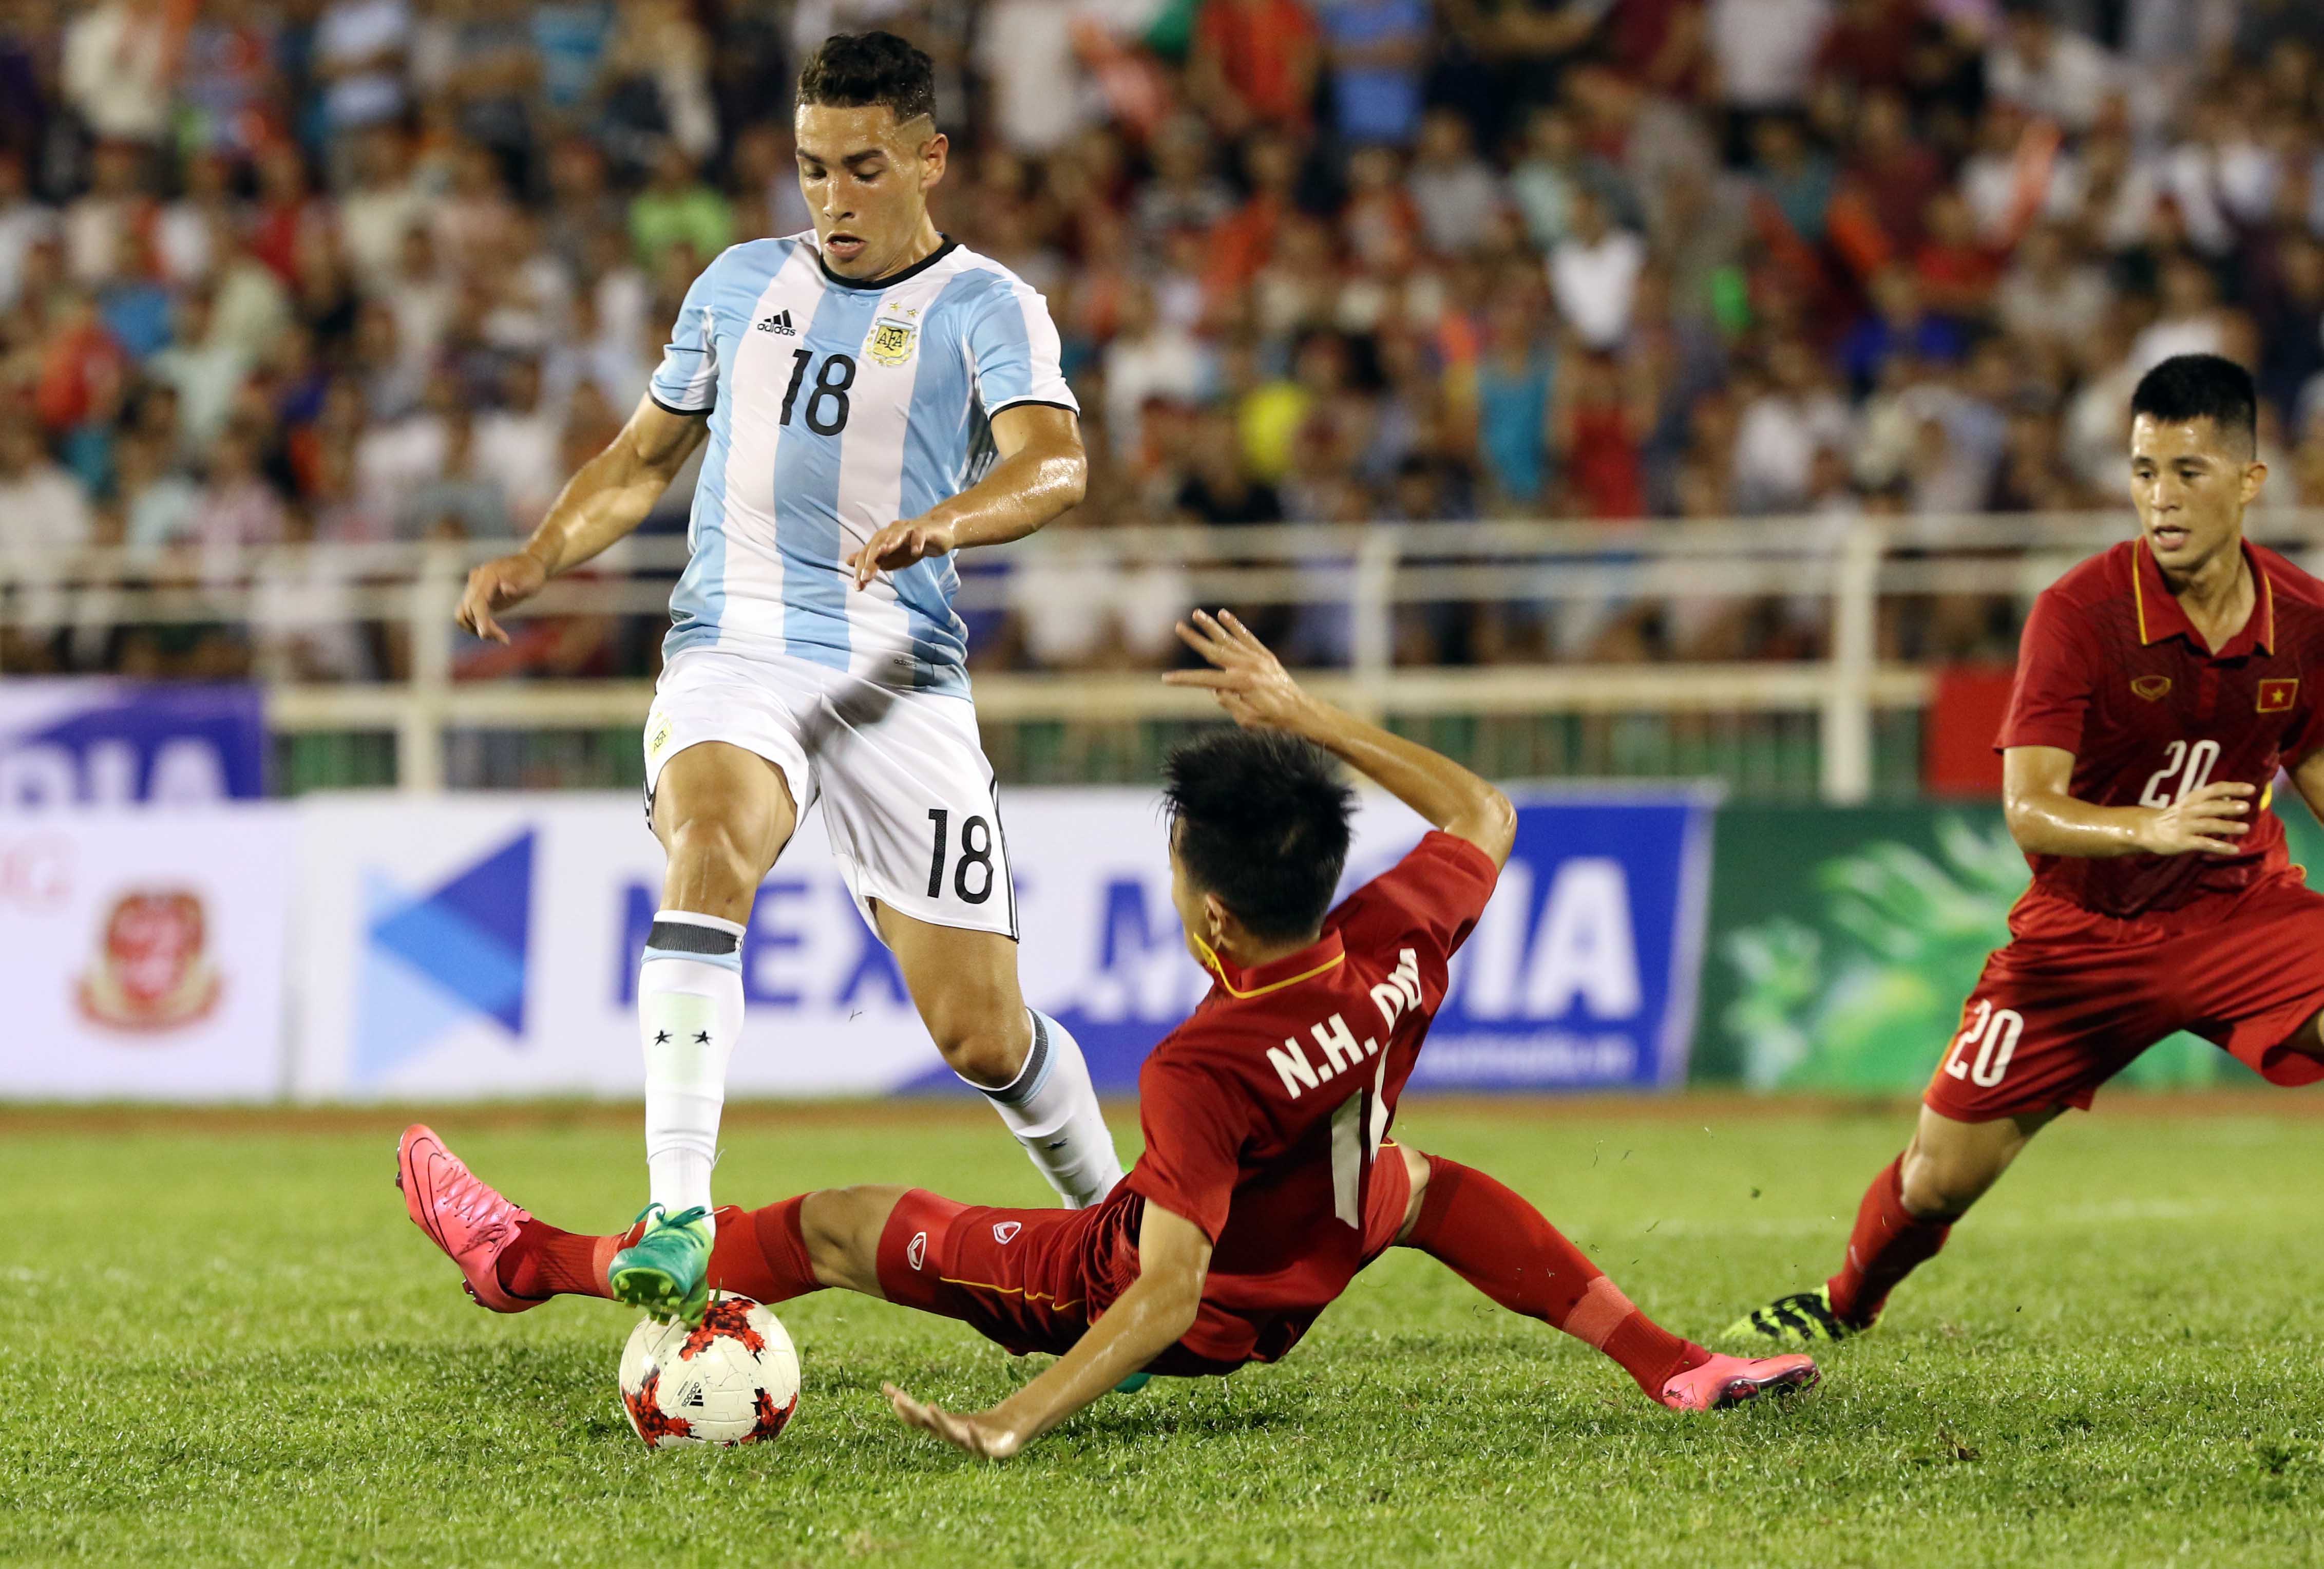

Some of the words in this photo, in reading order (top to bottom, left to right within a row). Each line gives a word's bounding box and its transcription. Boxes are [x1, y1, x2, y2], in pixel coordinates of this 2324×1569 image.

[757, 322, 796, 336] adidas
[877, 328, 903, 351] AFA
[780, 349, 856, 436] 18
[2138, 740, 2221, 810] 20
[927, 809, 994, 904] 18
[1091, 855, 1646, 1023] MIA
[1945, 999, 2024, 1087] 20
[681, 1382, 699, 1407] adidas
